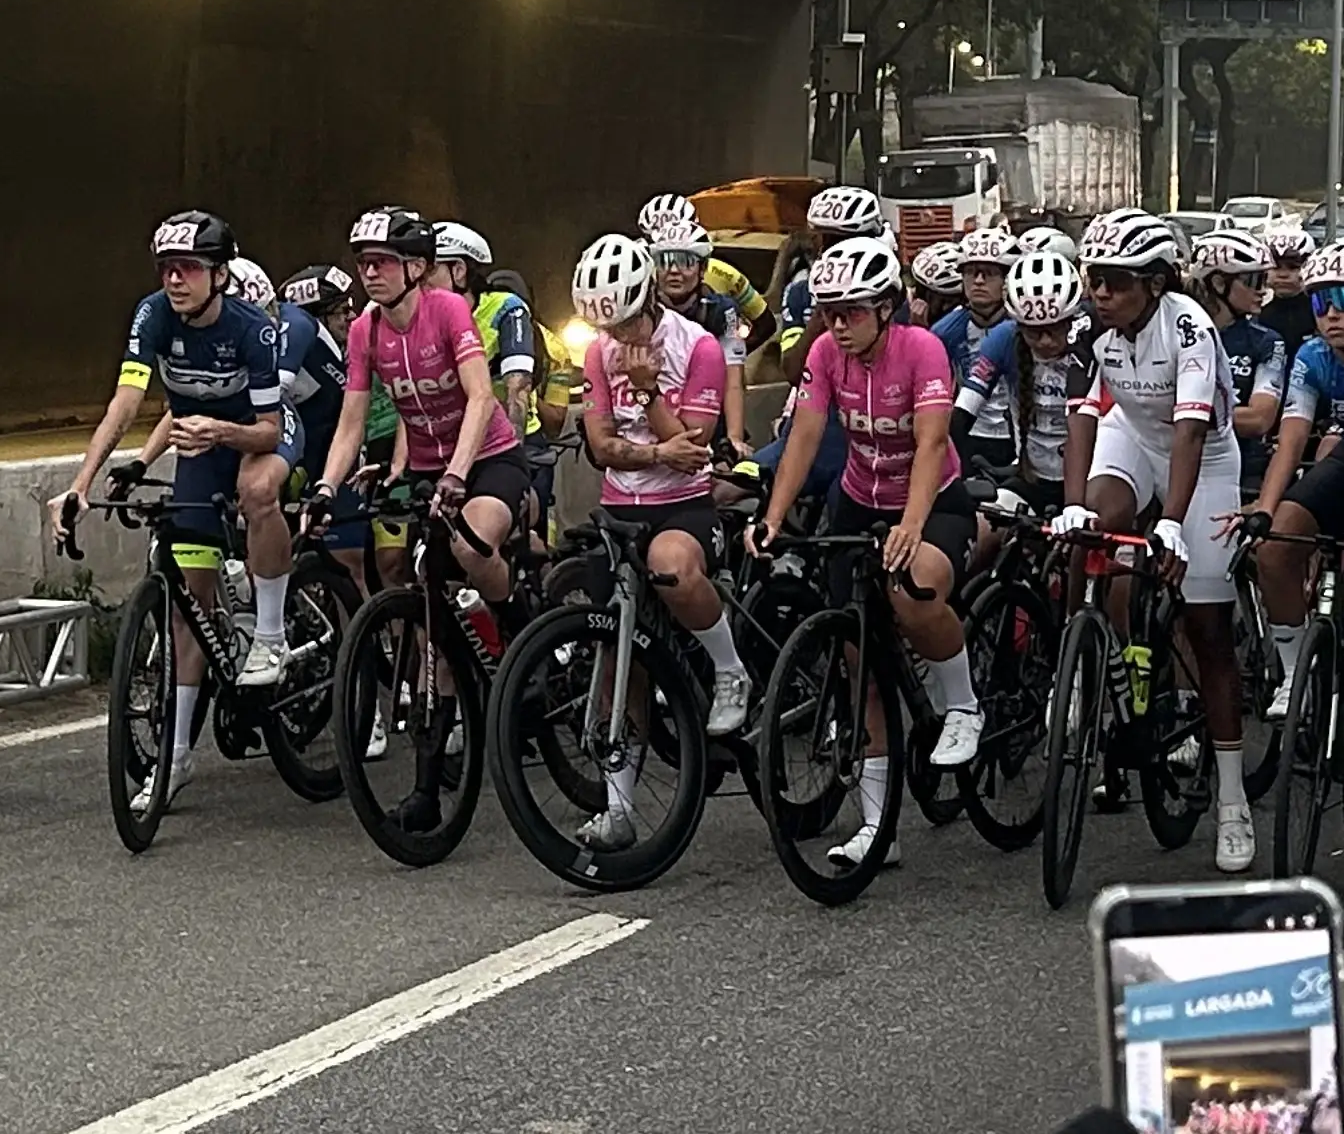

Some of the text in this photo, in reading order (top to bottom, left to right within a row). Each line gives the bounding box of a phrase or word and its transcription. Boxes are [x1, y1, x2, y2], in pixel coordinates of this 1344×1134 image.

[157, 225, 191, 246] 222
[658, 226, 688, 241] 207
[1084, 224, 1120, 245] 202
[968, 241, 1000, 257] 236
[813, 261, 849, 286] 237
[1305, 255, 1342, 279] 234
[1022, 297, 1060, 321] 235
